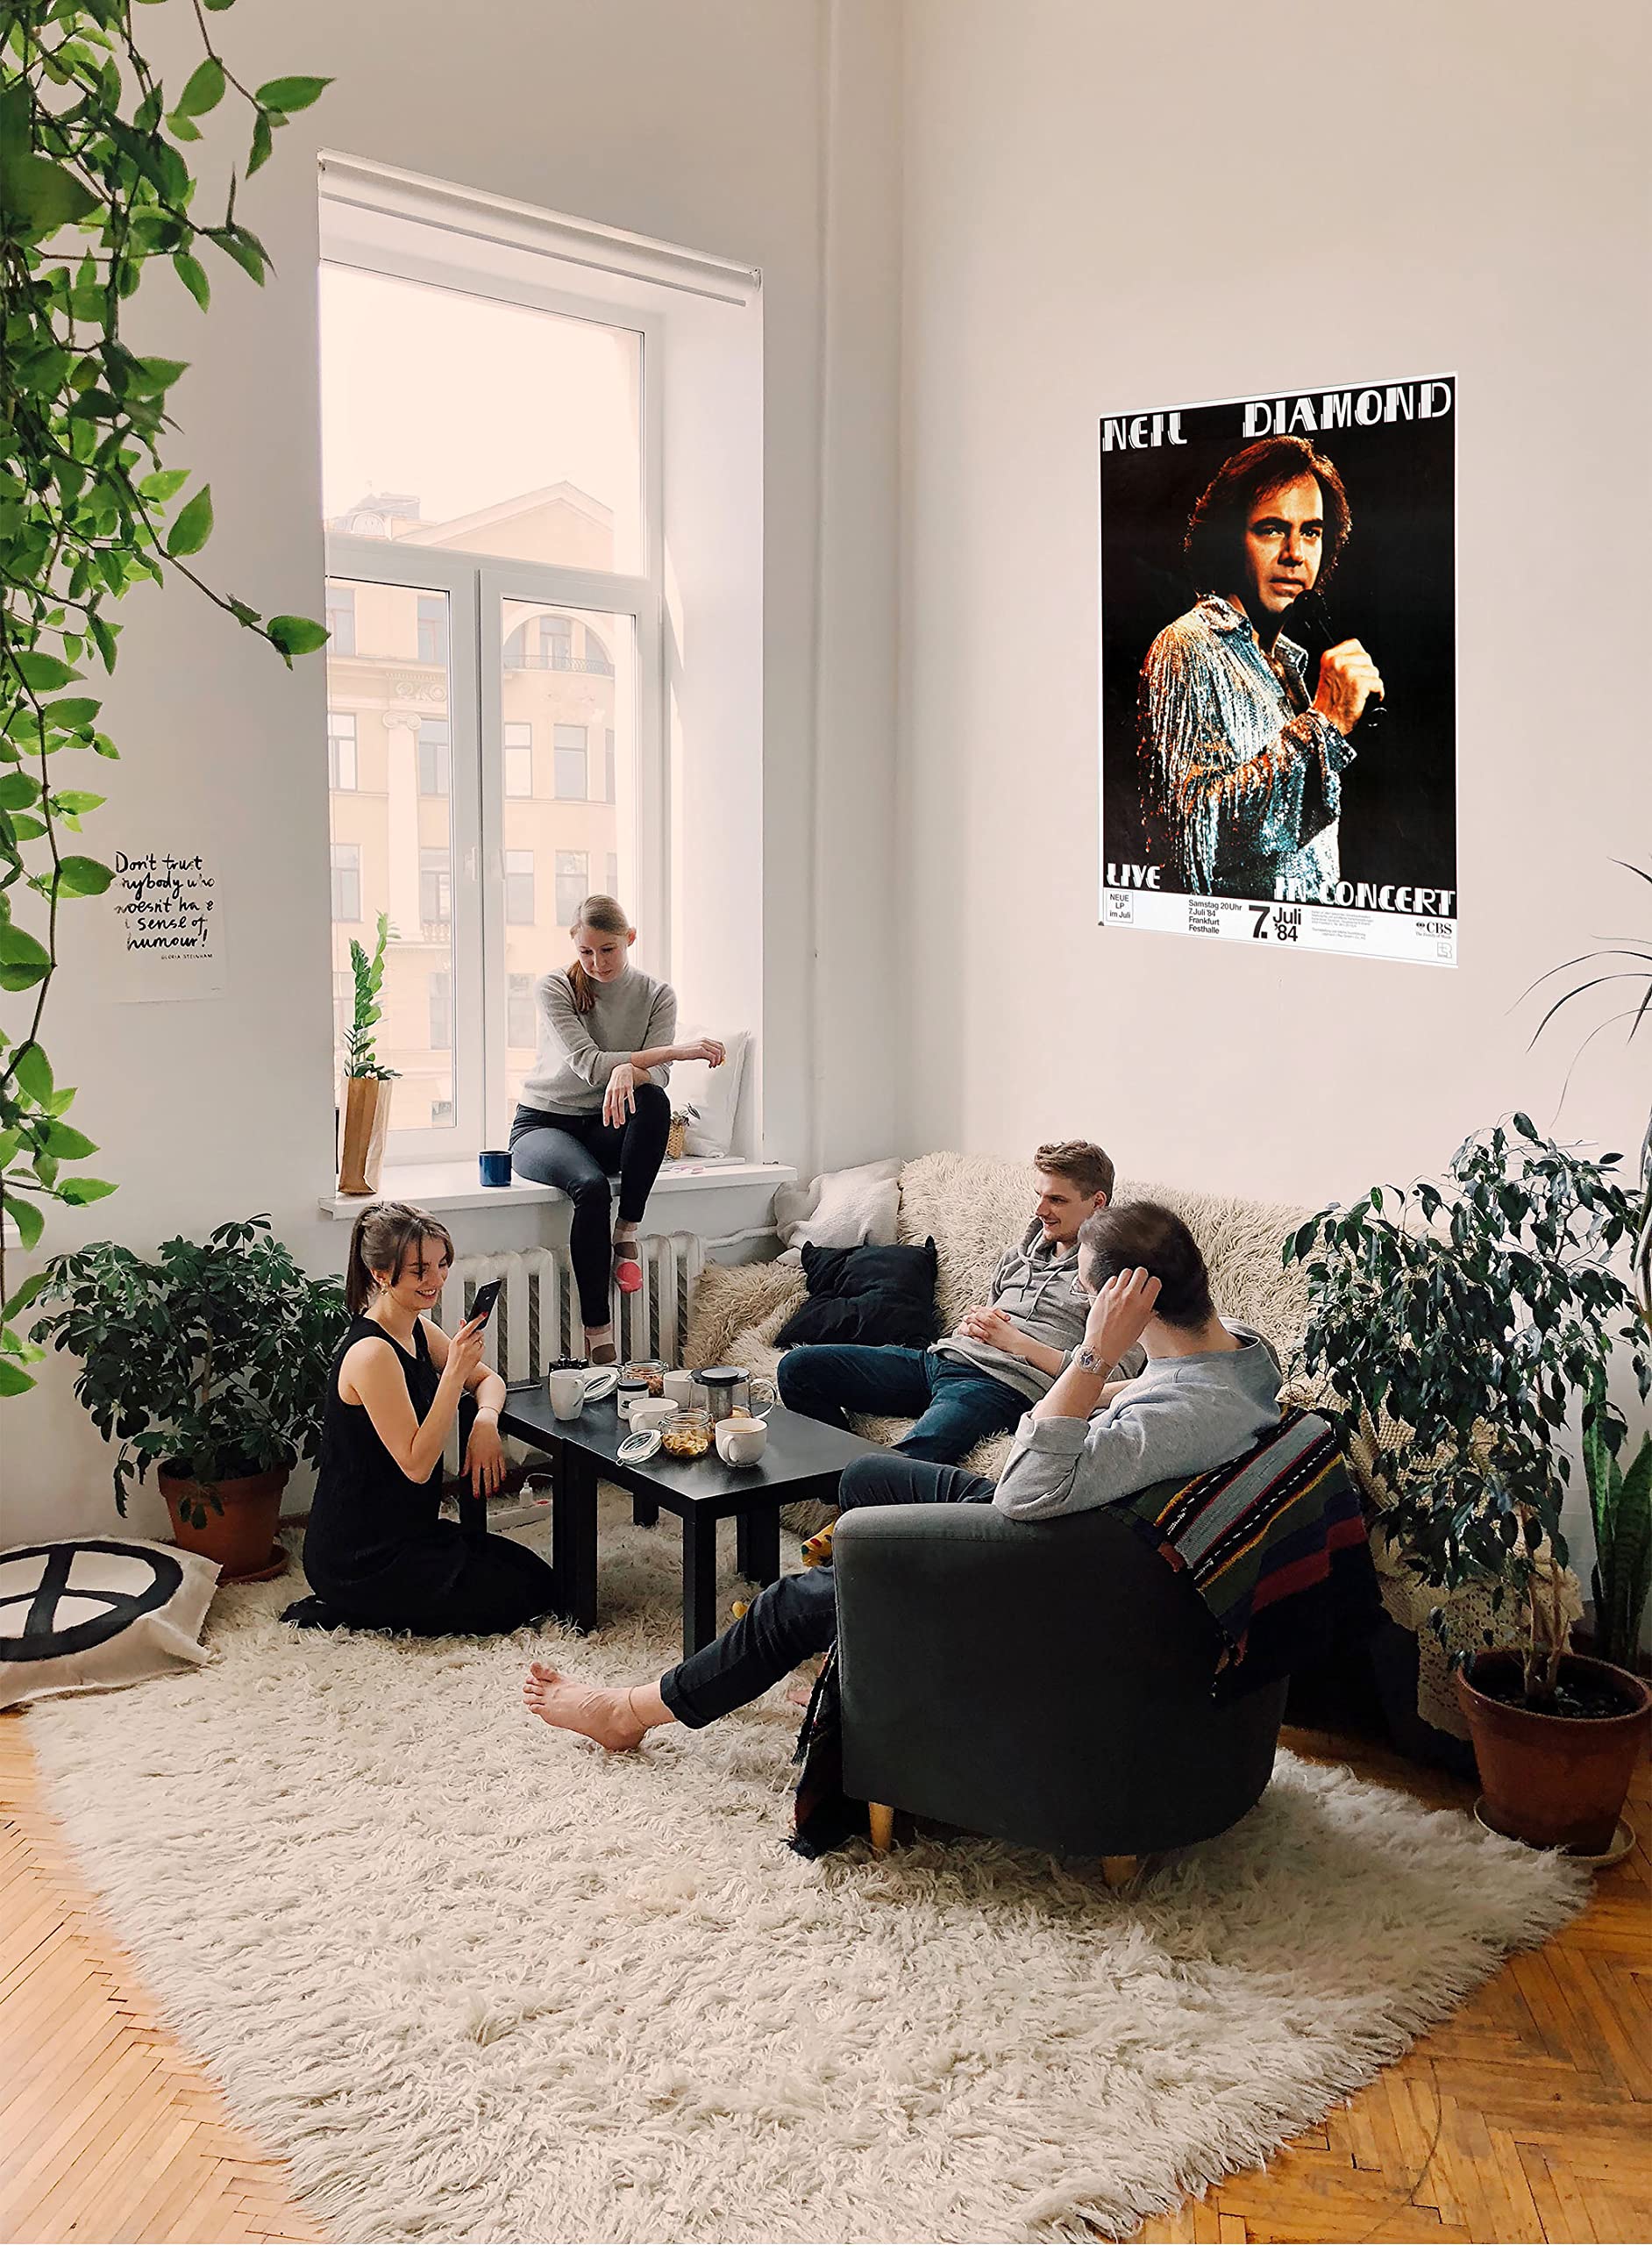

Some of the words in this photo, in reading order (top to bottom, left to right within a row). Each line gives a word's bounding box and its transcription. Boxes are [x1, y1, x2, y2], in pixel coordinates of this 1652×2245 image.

[1102, 412, 1187, 452] NEIL
[1243, 381, 1452, 438] DIAMOND
[116, 851, 157, 873] Don't
[115, 870, 183, 901] nybody
[1107, 862, 1161, 890] LIVE
[1318, 880, 1456, 916] CONCERT
[179, 896, 214, 913] hae
[1109, 893, 1129, 902] NEUE
[1188, 899, 1220, 911] Samstag
[137, 916, 187, 931] sense
[1188, 916, 1220, 926] Frankfurt
[1188, 923, 1220, 935] Festhalle
[1249, 904, 1271, 939] 7.
[1272, 907, 1302, 925] Juli
[1426, 921, 1452, 936] CBS
[1274, 923, 1299, 943] '84
